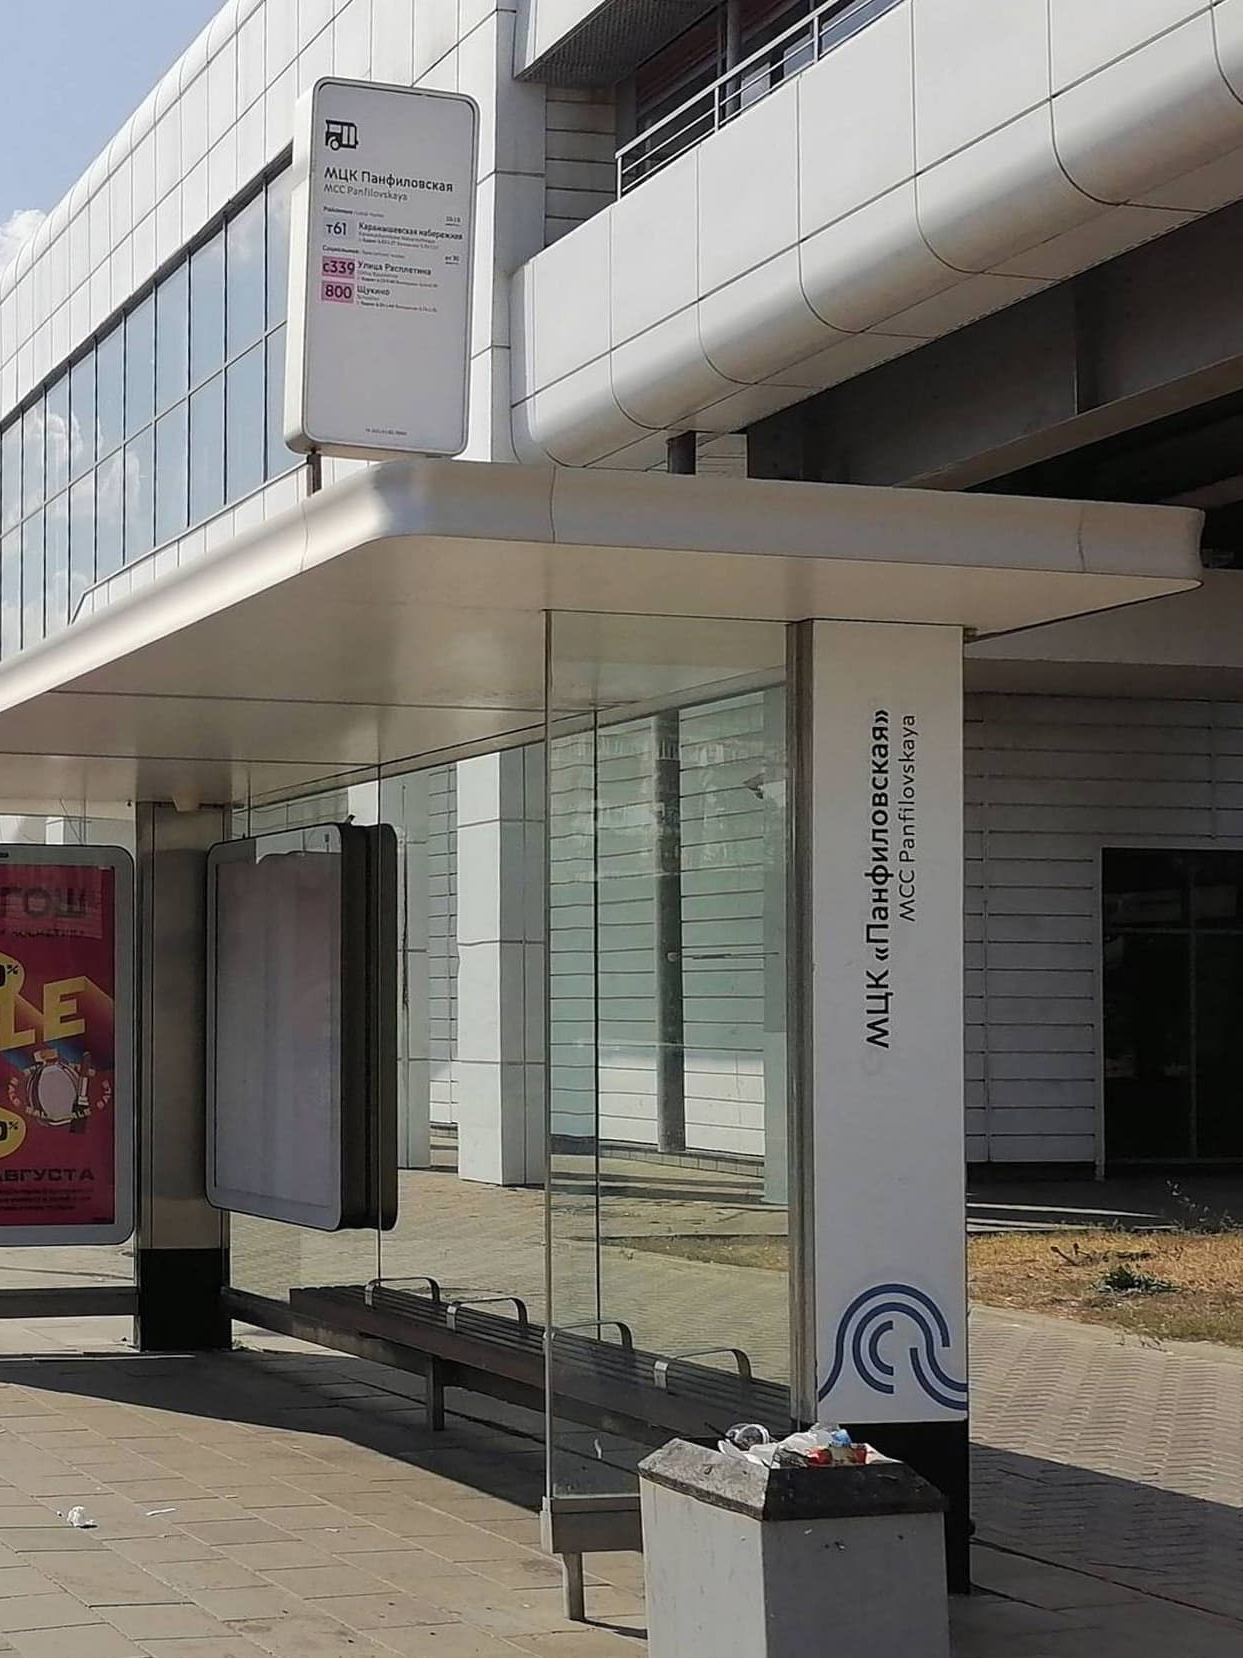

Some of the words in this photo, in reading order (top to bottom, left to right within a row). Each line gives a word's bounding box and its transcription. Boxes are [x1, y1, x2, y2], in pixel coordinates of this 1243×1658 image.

[323, 184, 345, 194] MCC
[347, 186, 408, 202] Panfilovskaya
[324, 167, 357, 182] МЦК
[361, 171, 453, 192] Панфиловская
[358, 261, 383, 272] Улица
[325, 284, 352, 299] 800
[898, 715, 919, 862] Panfilovskaya
[864, 709, 894, 962] «Панфиловская»
[1, 886, 87, 919] ГОШ
[899, 869, 916, 922] MCC
[866, 970, 893, 1048] МЦК
